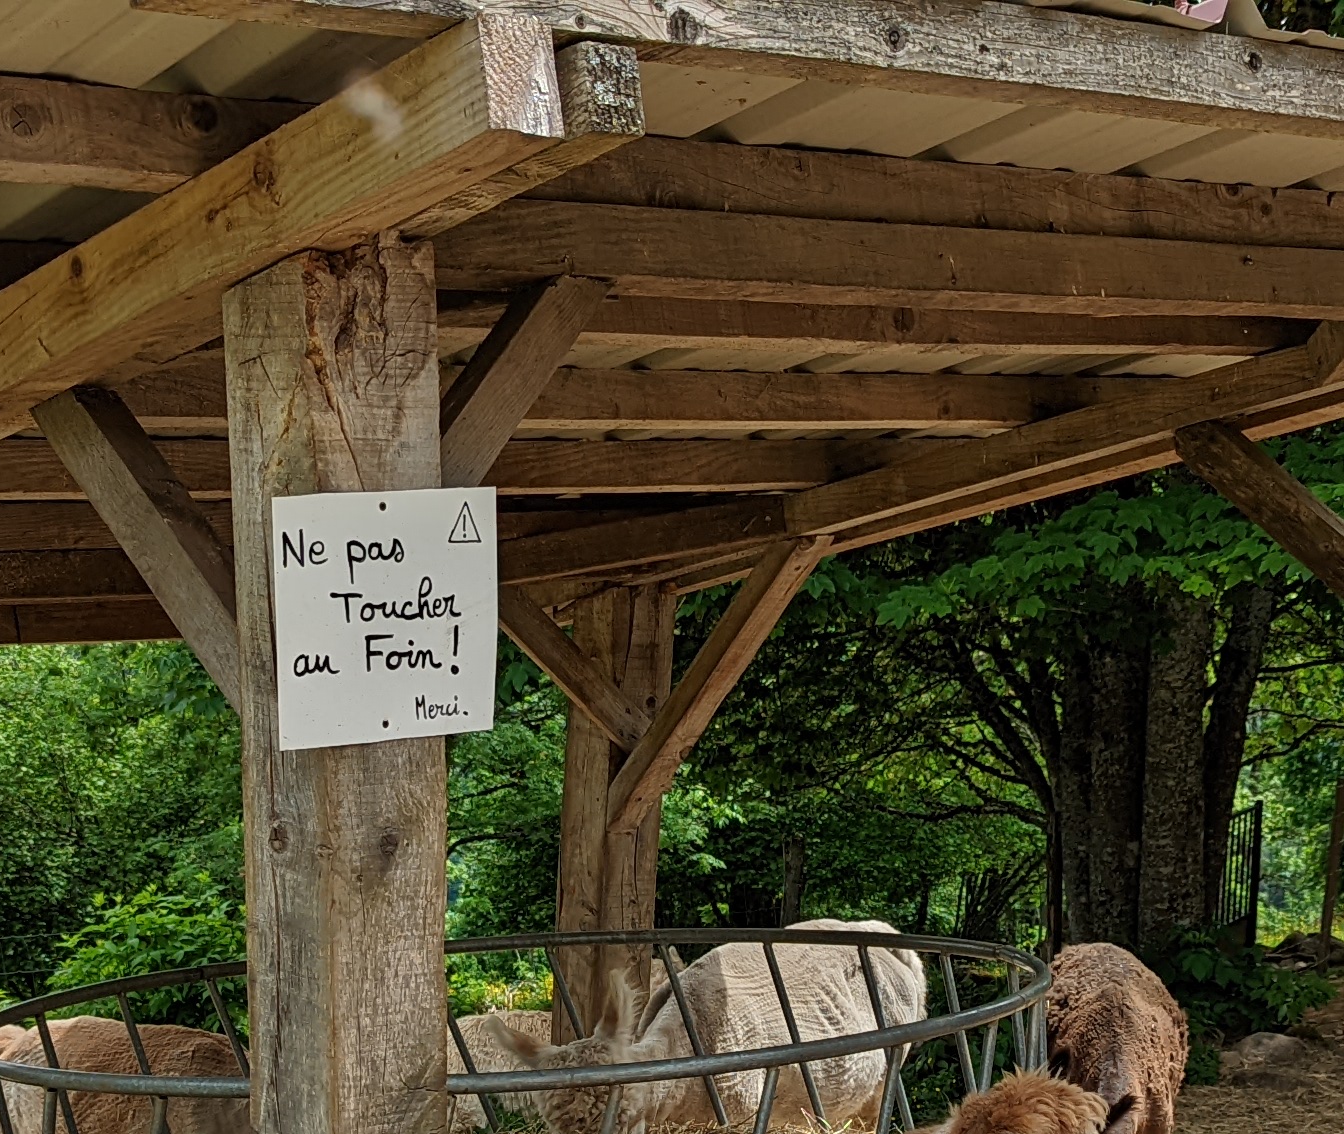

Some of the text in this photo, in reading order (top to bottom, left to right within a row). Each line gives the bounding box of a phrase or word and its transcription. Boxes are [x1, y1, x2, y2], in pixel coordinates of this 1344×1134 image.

[282, 528, 405, 585] Ne pas
[330, 576, 462, 625] Toucher
[293, 653, 341, 678] au
[414, 694, 469, 720] Merci.
